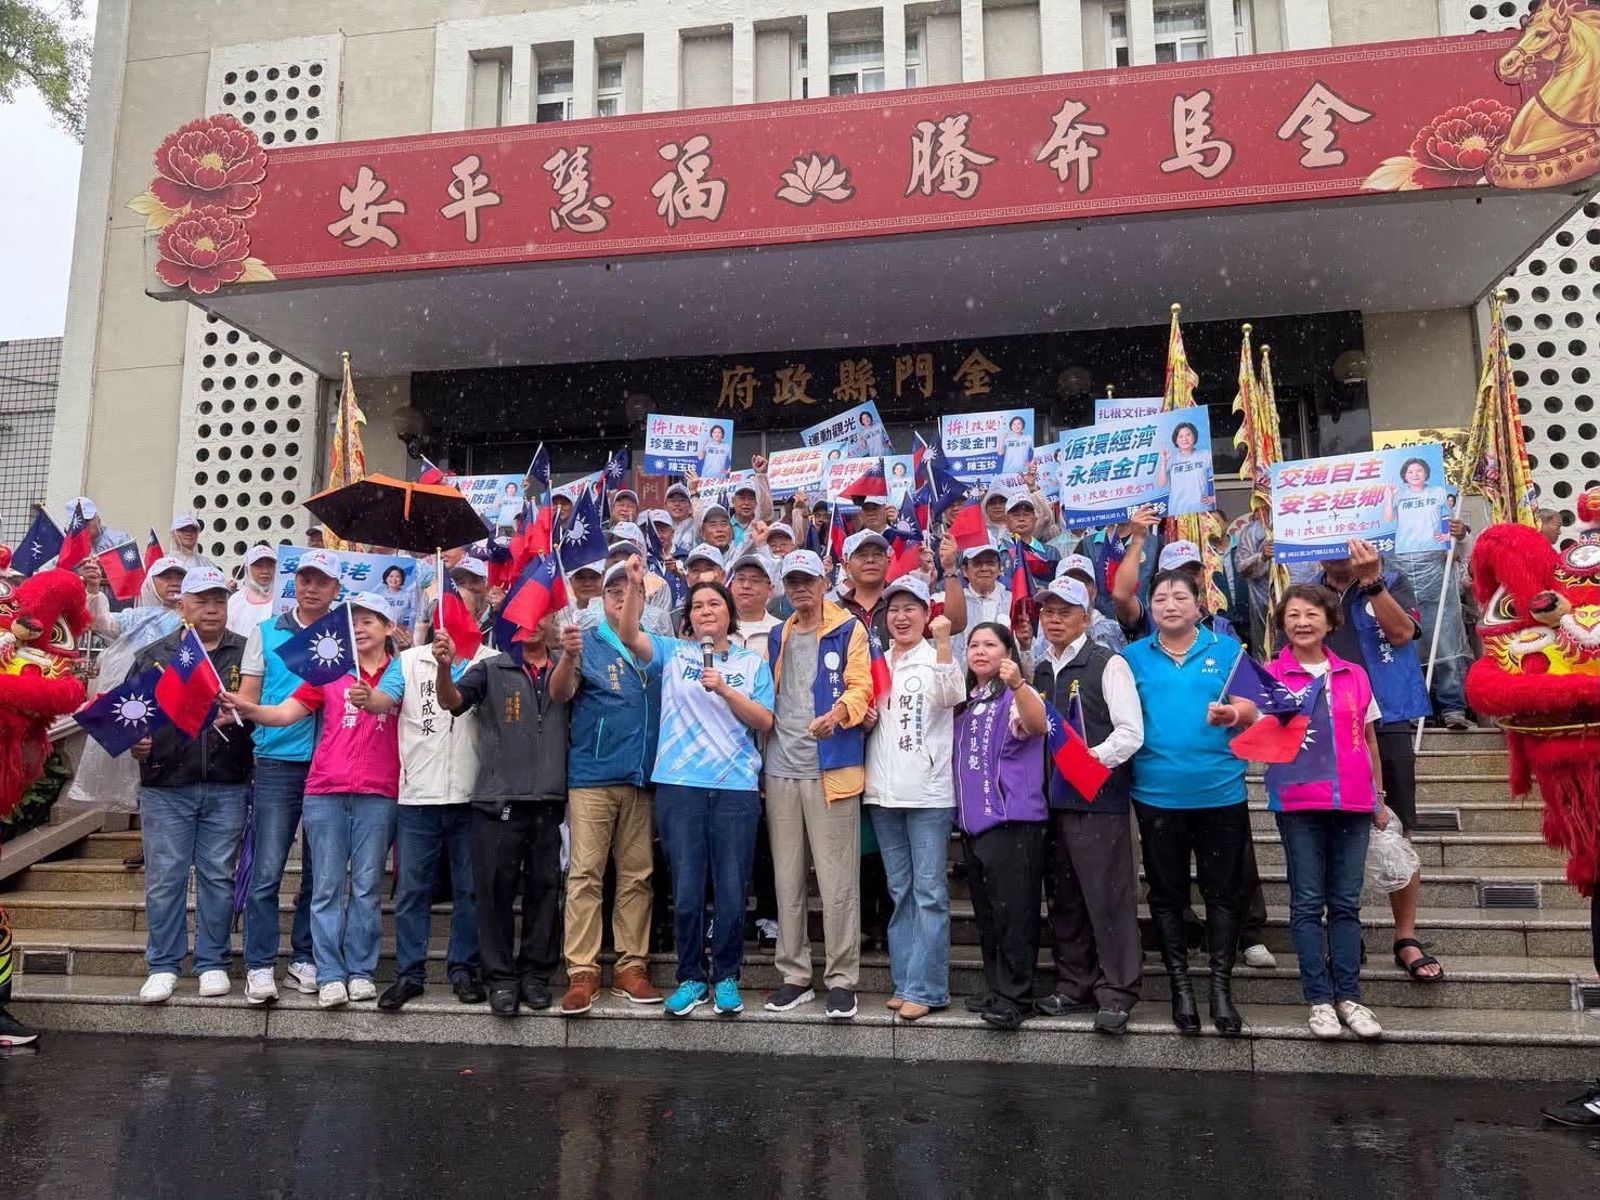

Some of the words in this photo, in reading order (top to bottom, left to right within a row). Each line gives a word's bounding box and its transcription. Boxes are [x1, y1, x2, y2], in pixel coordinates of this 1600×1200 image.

[717, 350, 1002, 409] 金門縣政府
[649, 437, 699, 453] 珍愛金門
[808, 416, 857, 447] 運動觀光
[947, 436, 998, 451] 珍愛金門
[1063, 424, 1158, 462] 循環經濟
[1065, 452, 1160, 487] 永續金門
[1276, 459, 1384, 489] 交通自主
[1277, 485, 1388, 517] 安全返鄉
[682, 665, 745, 687] 陳珍
[420, 680, 437, 736] 陳成泉
